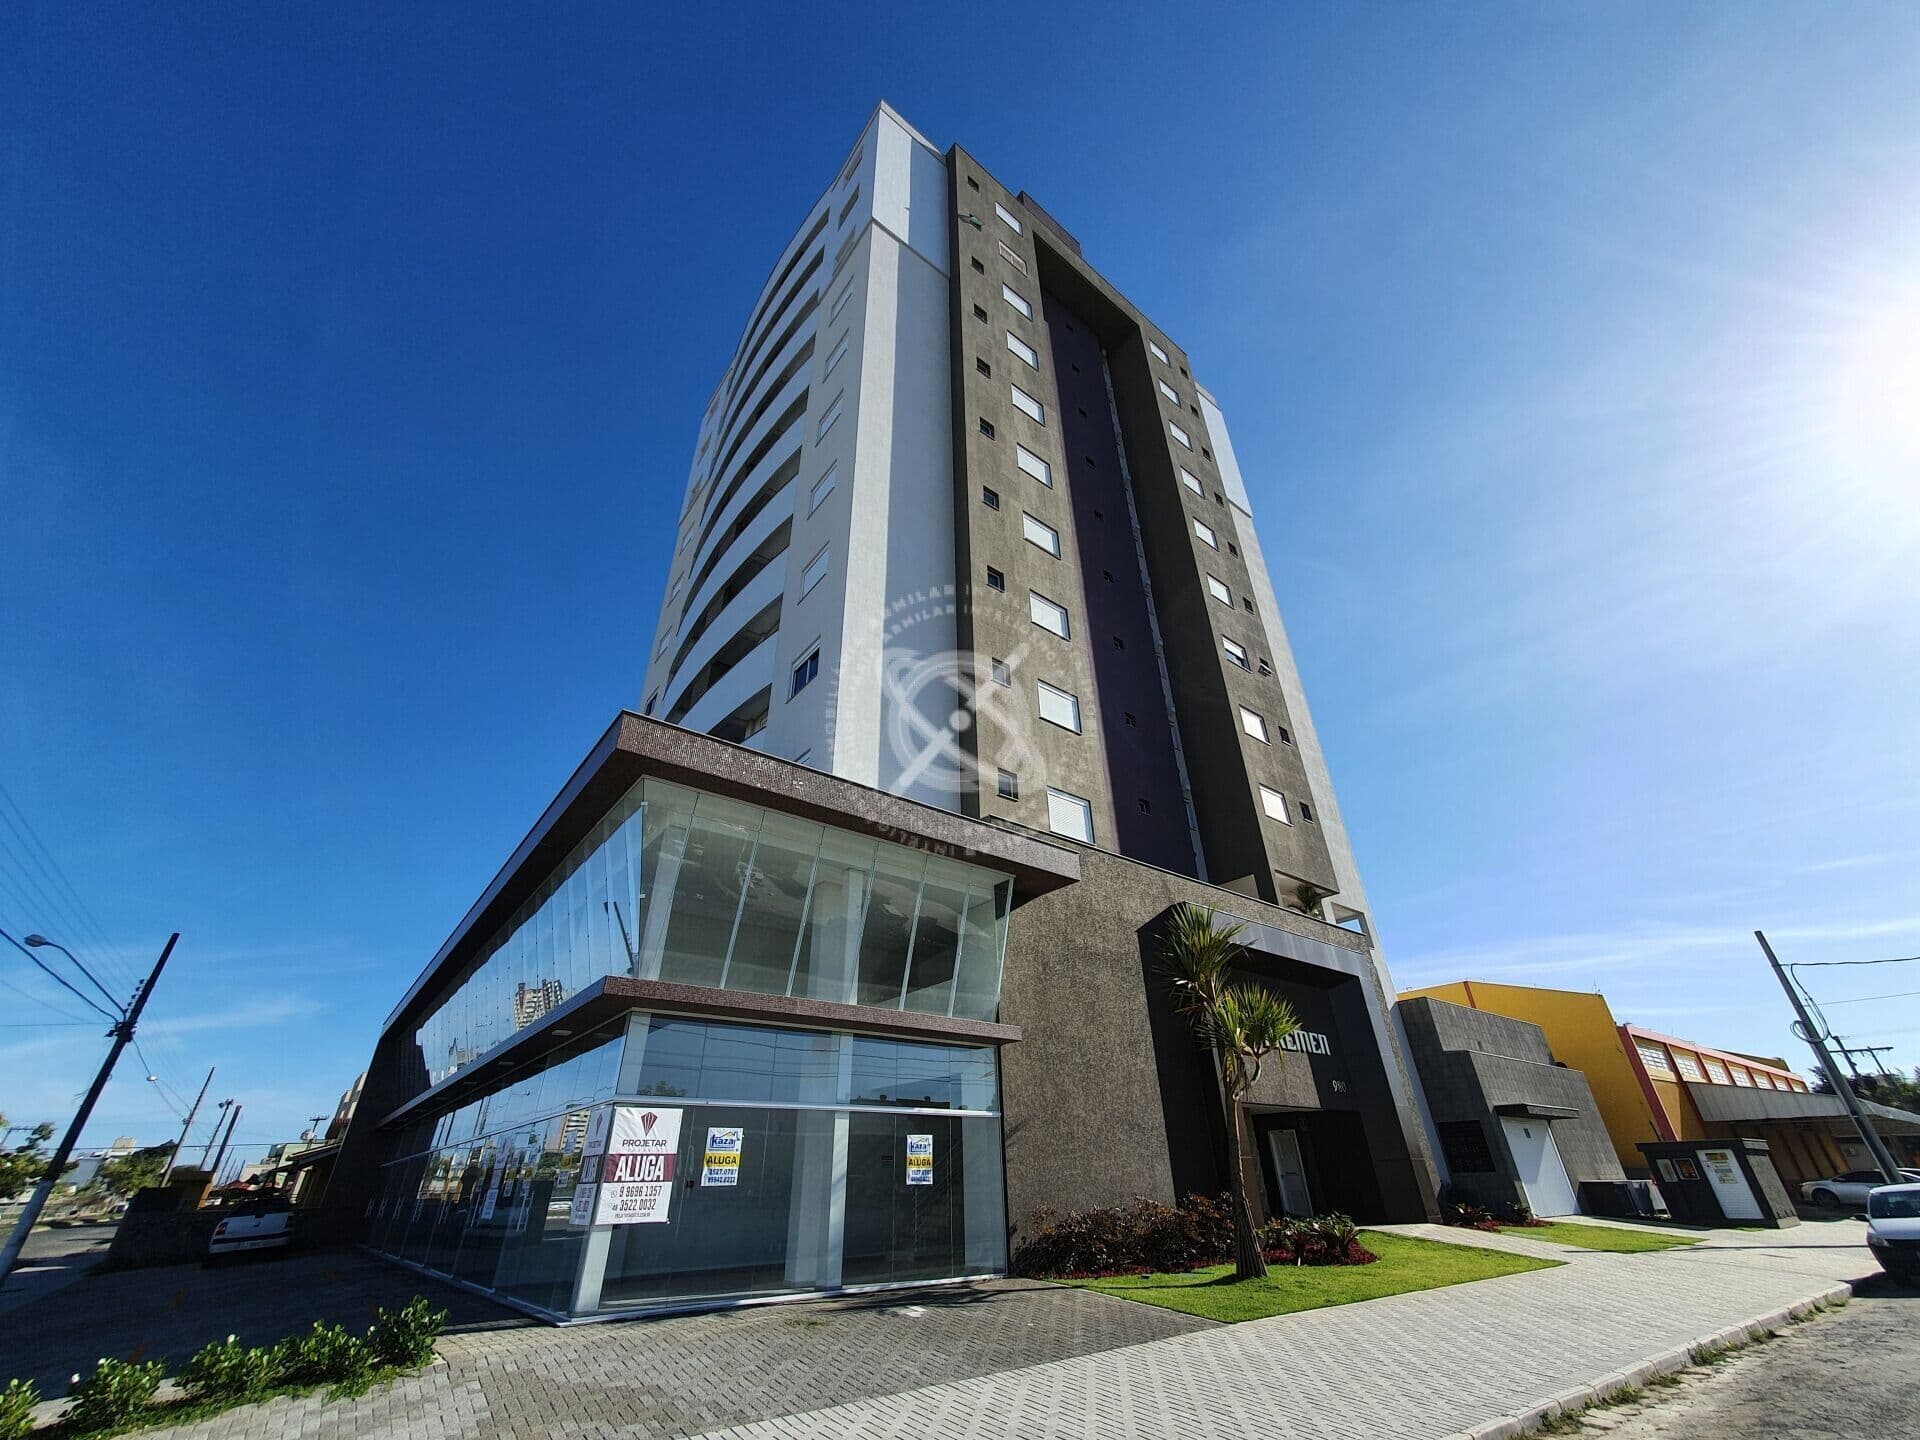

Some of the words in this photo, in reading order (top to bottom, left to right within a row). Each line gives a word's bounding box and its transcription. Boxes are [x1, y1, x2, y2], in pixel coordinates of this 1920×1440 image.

[621, 1139, 667, 1148] PROJETAR
[706, 1155, 737, 1165] ALUGA
[908, 1158, 931, 1166] ALUGA
[613, 1155, 665, 1182] ALUGA
[619, 1186, 625, 1198] 9
[645, 1185, 662, 1197] 1357
[620, 1199, 637, 1212] 3522
[639, 1198, 657, 1211] 0032
